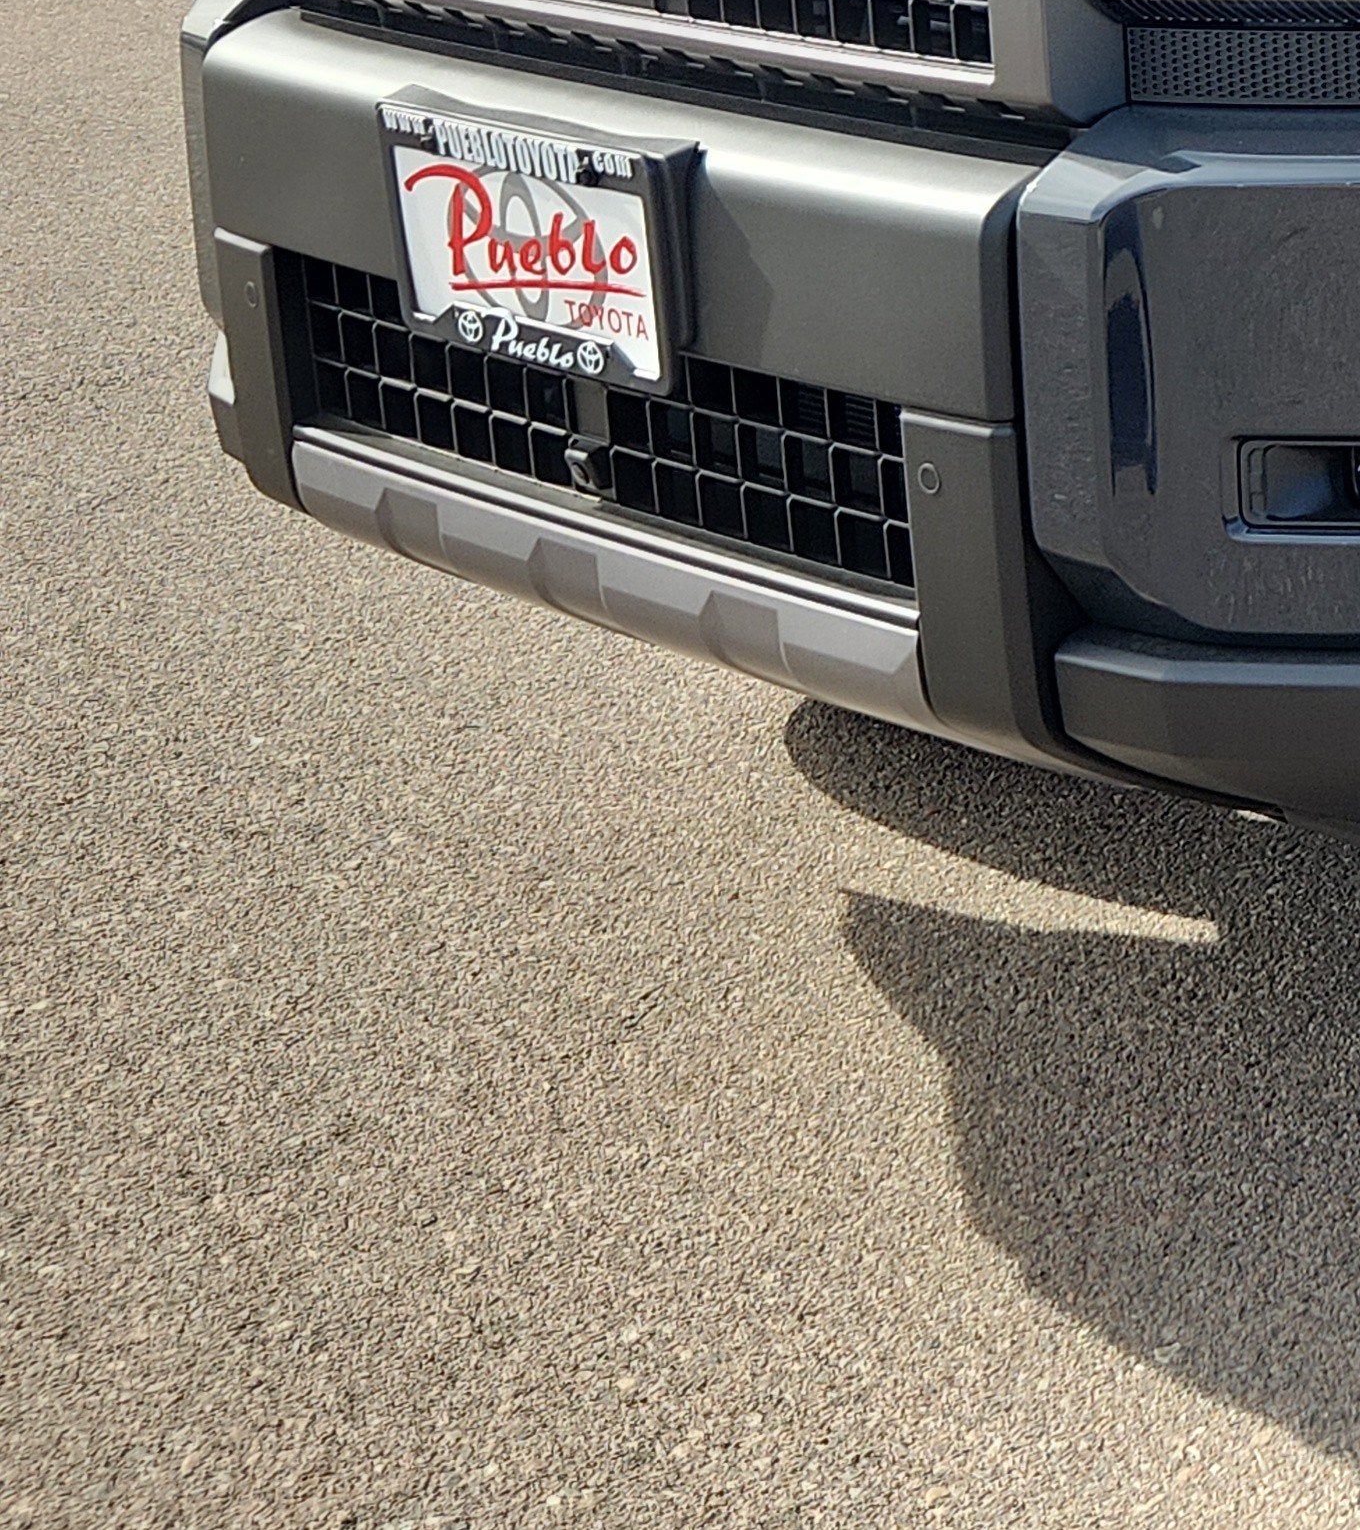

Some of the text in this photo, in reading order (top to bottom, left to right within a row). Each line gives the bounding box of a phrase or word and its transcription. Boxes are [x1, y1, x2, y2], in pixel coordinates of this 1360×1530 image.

[403, 163, 638, 275] Pueblo
[479, 306, 575, 369] Pueblo
[564, 299, 649, 341] TOYOTA
